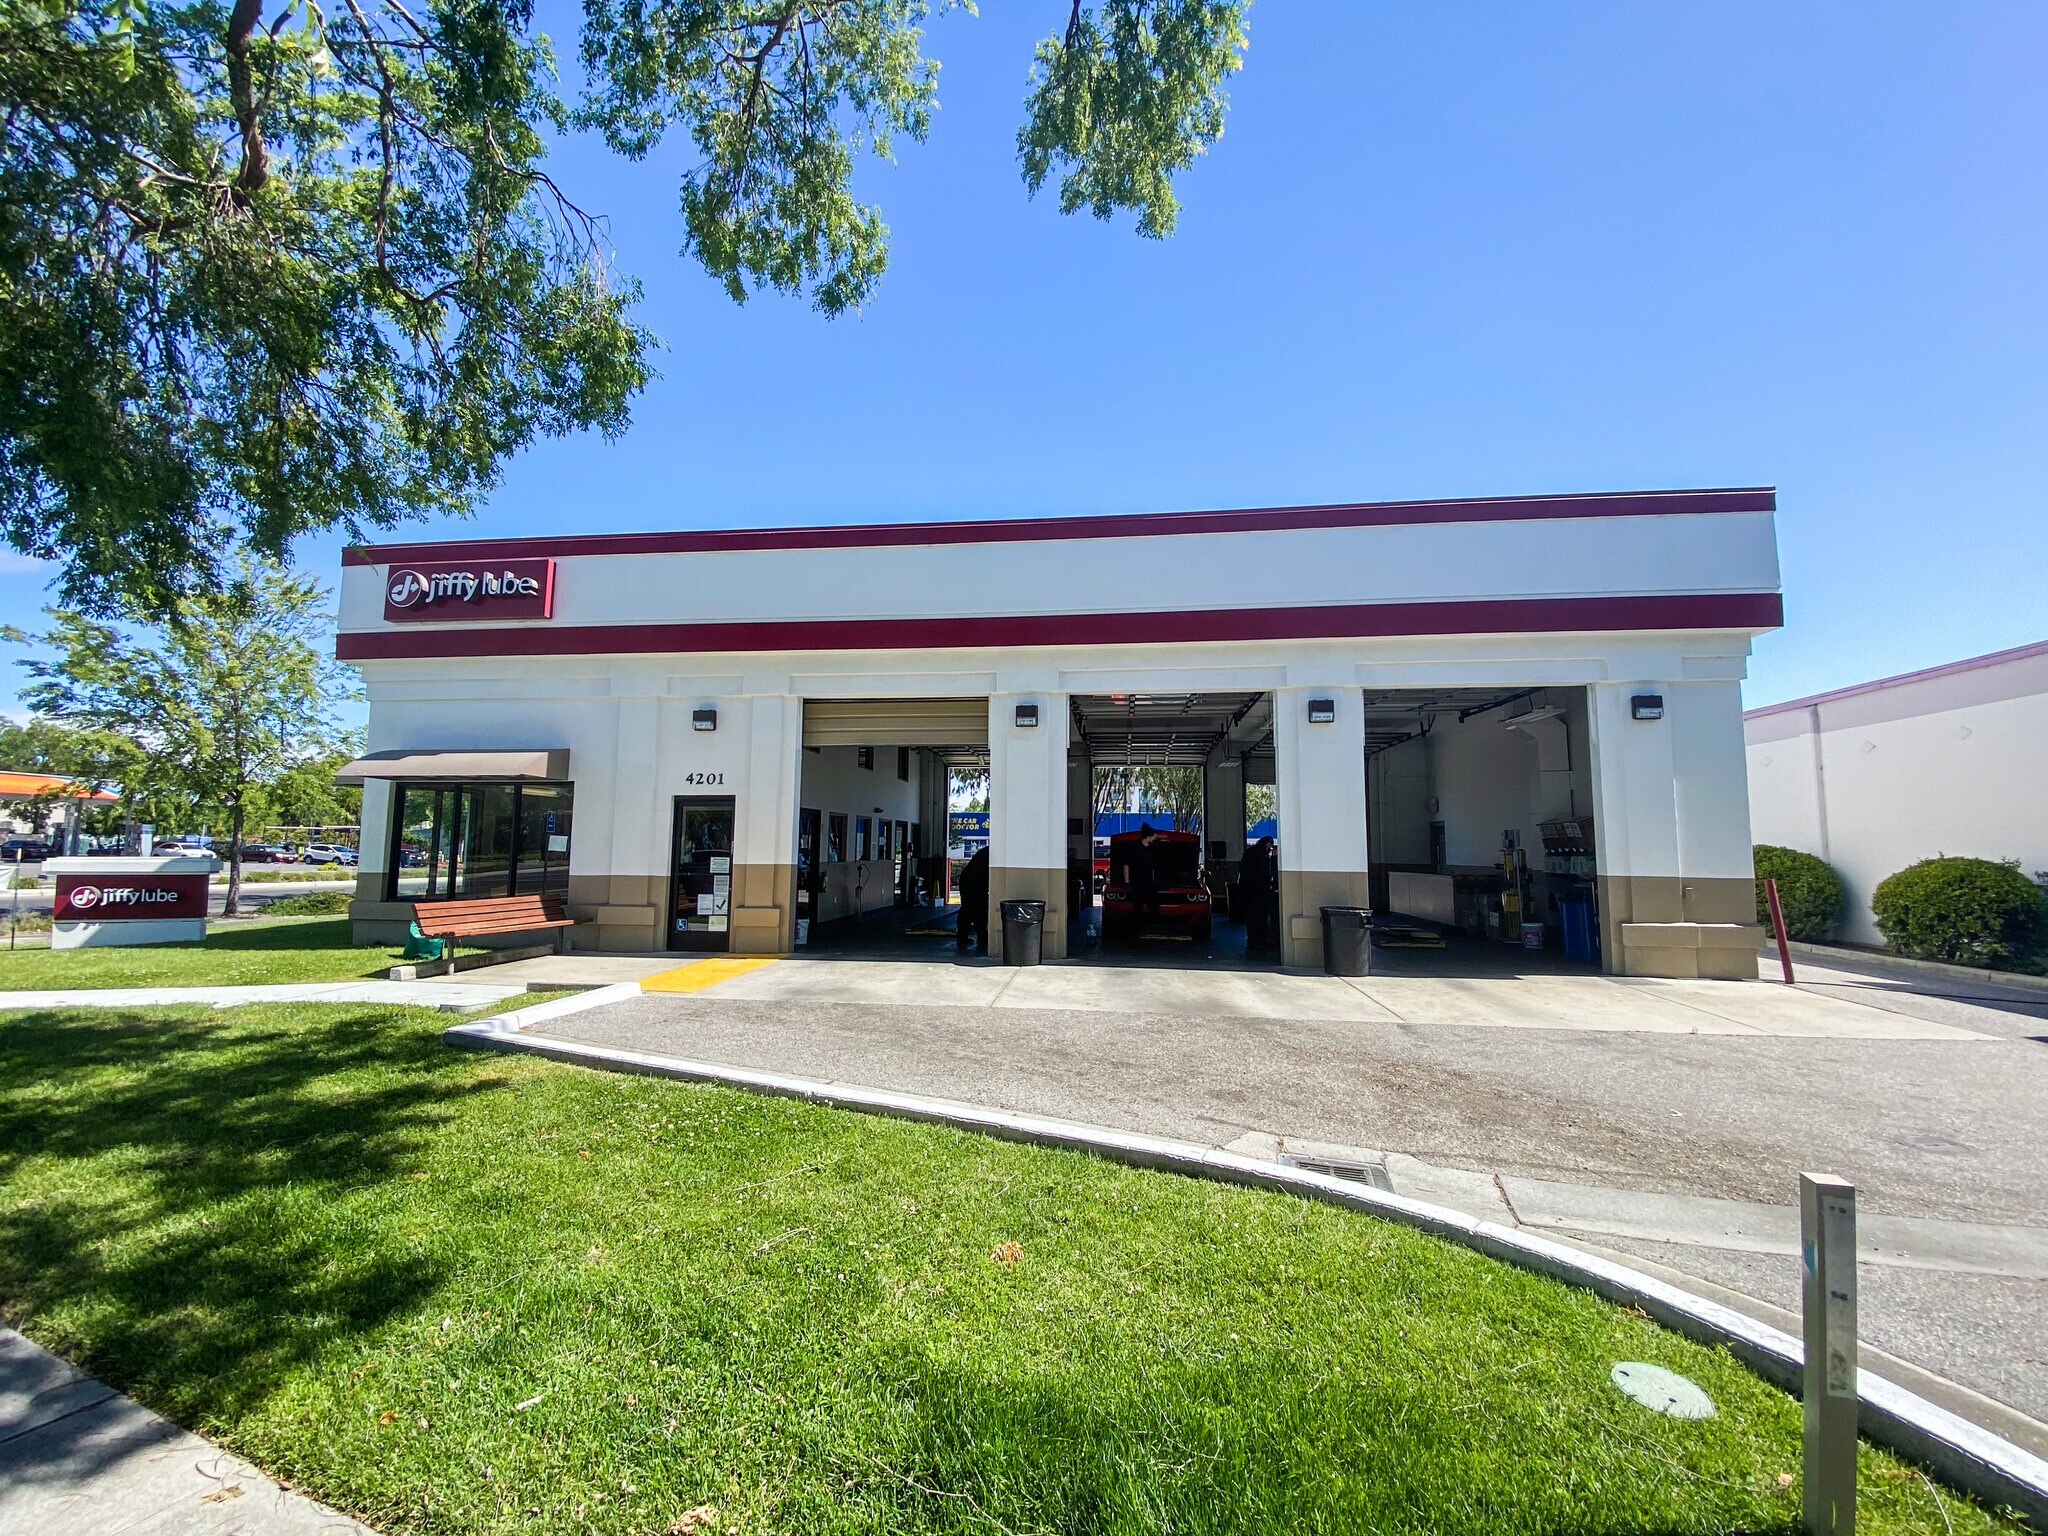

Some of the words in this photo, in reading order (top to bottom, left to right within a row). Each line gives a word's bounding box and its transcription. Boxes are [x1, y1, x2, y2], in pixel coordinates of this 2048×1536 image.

[426, 572, 479, 603] jiffy
[482, 570, 536, 595] lube
[686, 773, 725, 785] 4201
[100, 888, 140, 906] jiffy
[141, 888, 178, 902] lube
